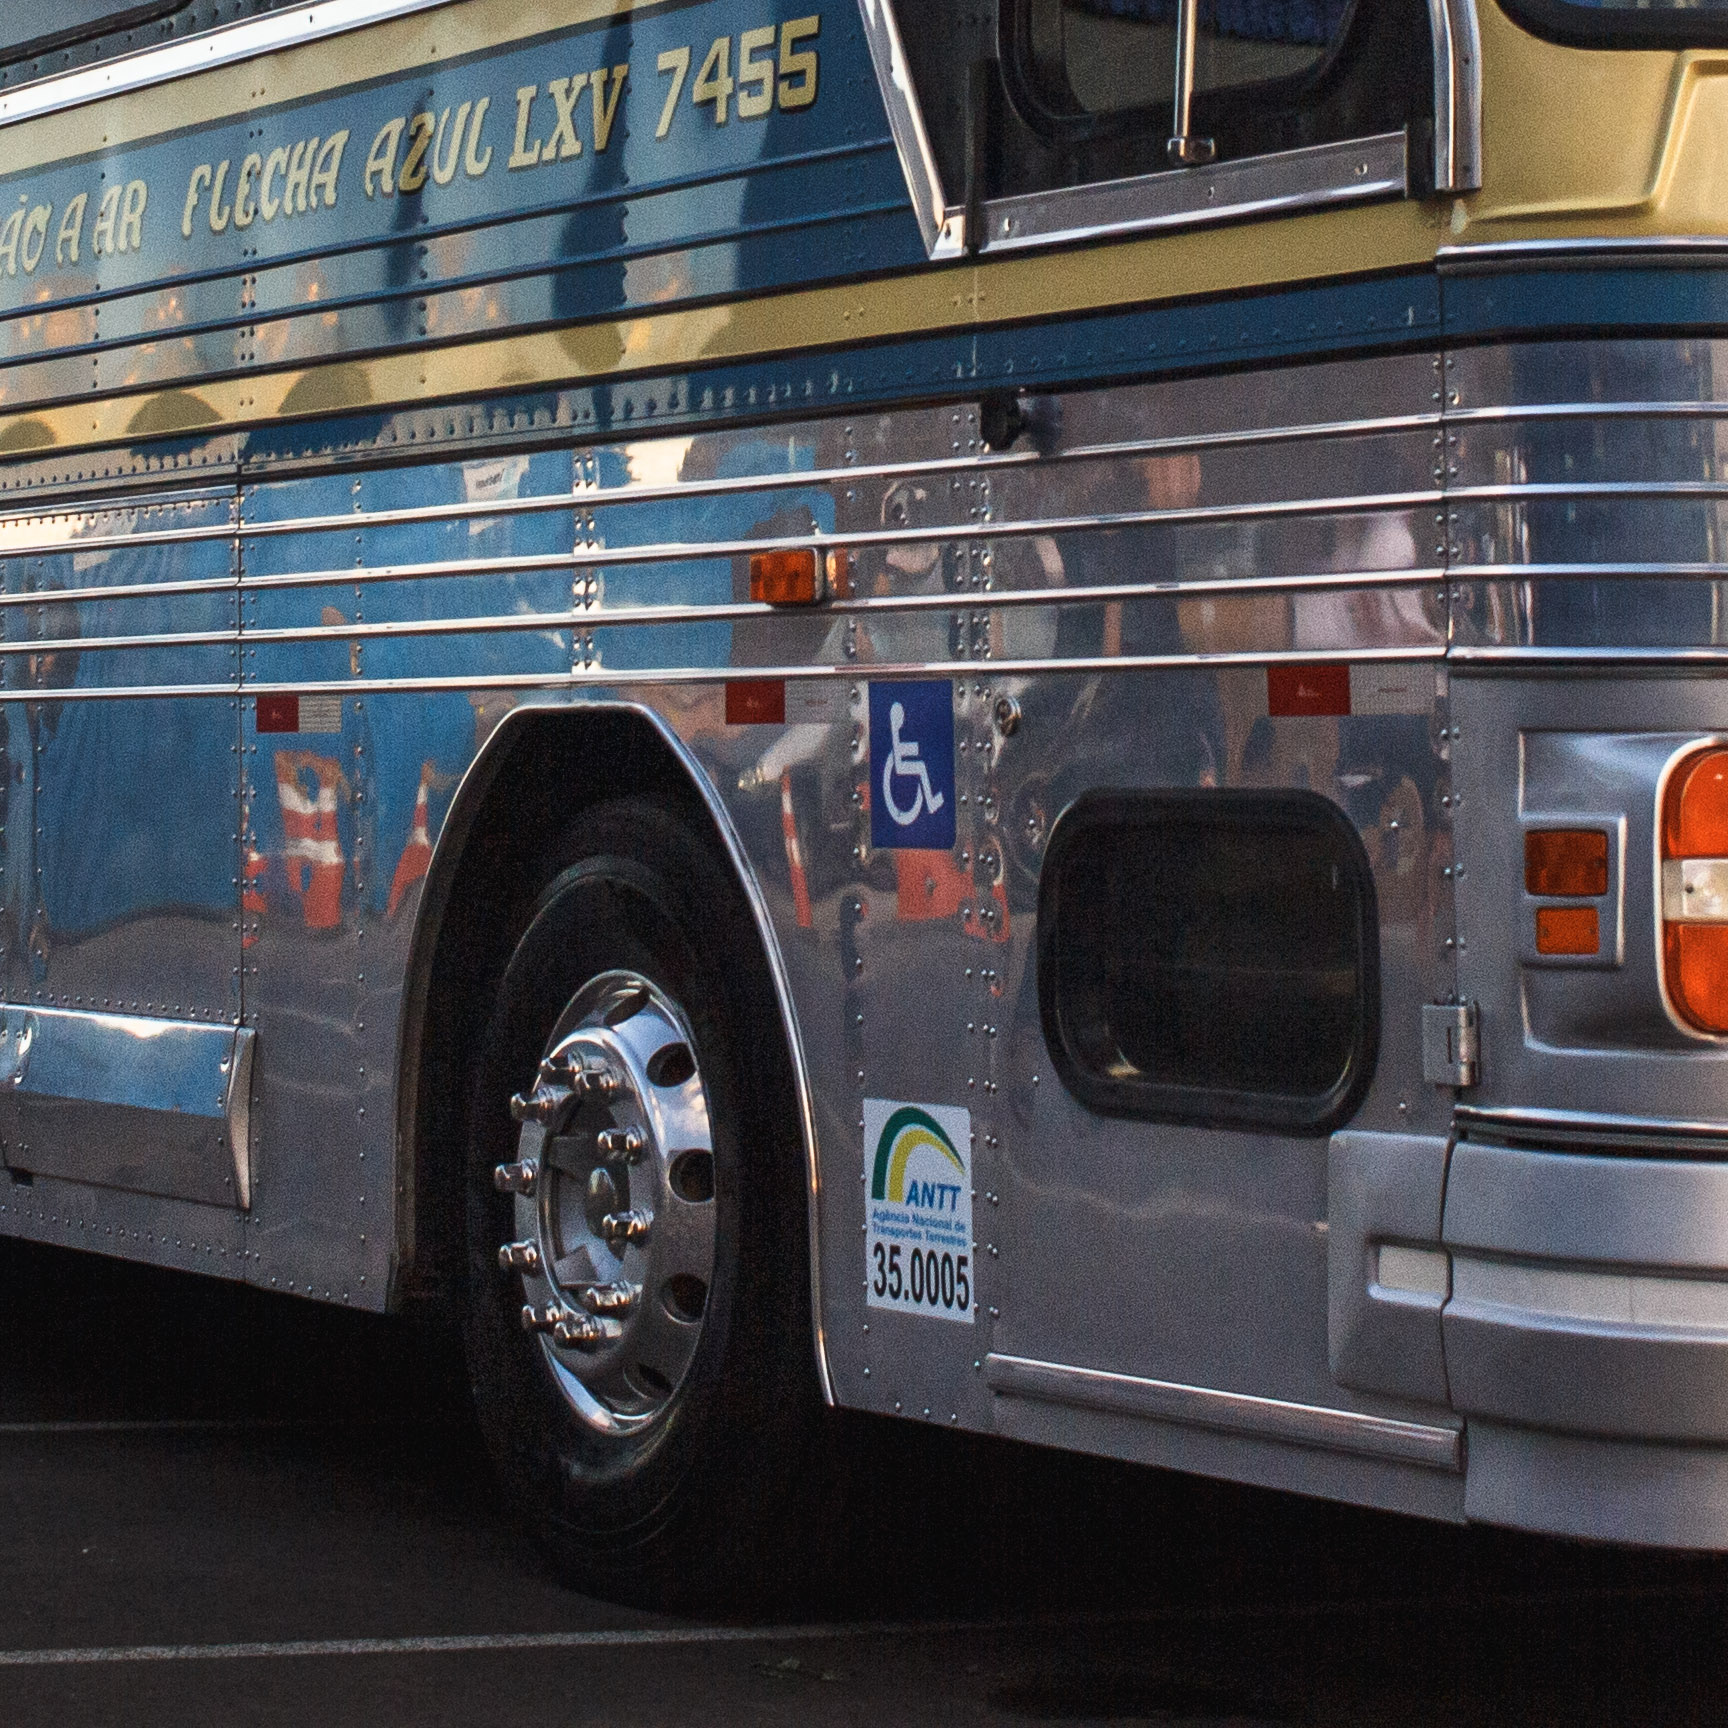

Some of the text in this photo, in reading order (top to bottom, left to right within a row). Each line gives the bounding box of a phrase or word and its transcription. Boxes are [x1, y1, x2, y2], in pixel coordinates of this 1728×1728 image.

[56, 192, 88, 264] A
[93, 180, 149, 255] AR
[181, 129, 351, 238] FLECHA
[364, 96, 493, 198] AZUL
[508, 62, 629, 170] LXV
[654, 14, 821, 142] 7455
[905, 1179, 962, 1213] ANTT
[873, 1241, 970, 1312] 35.0005
